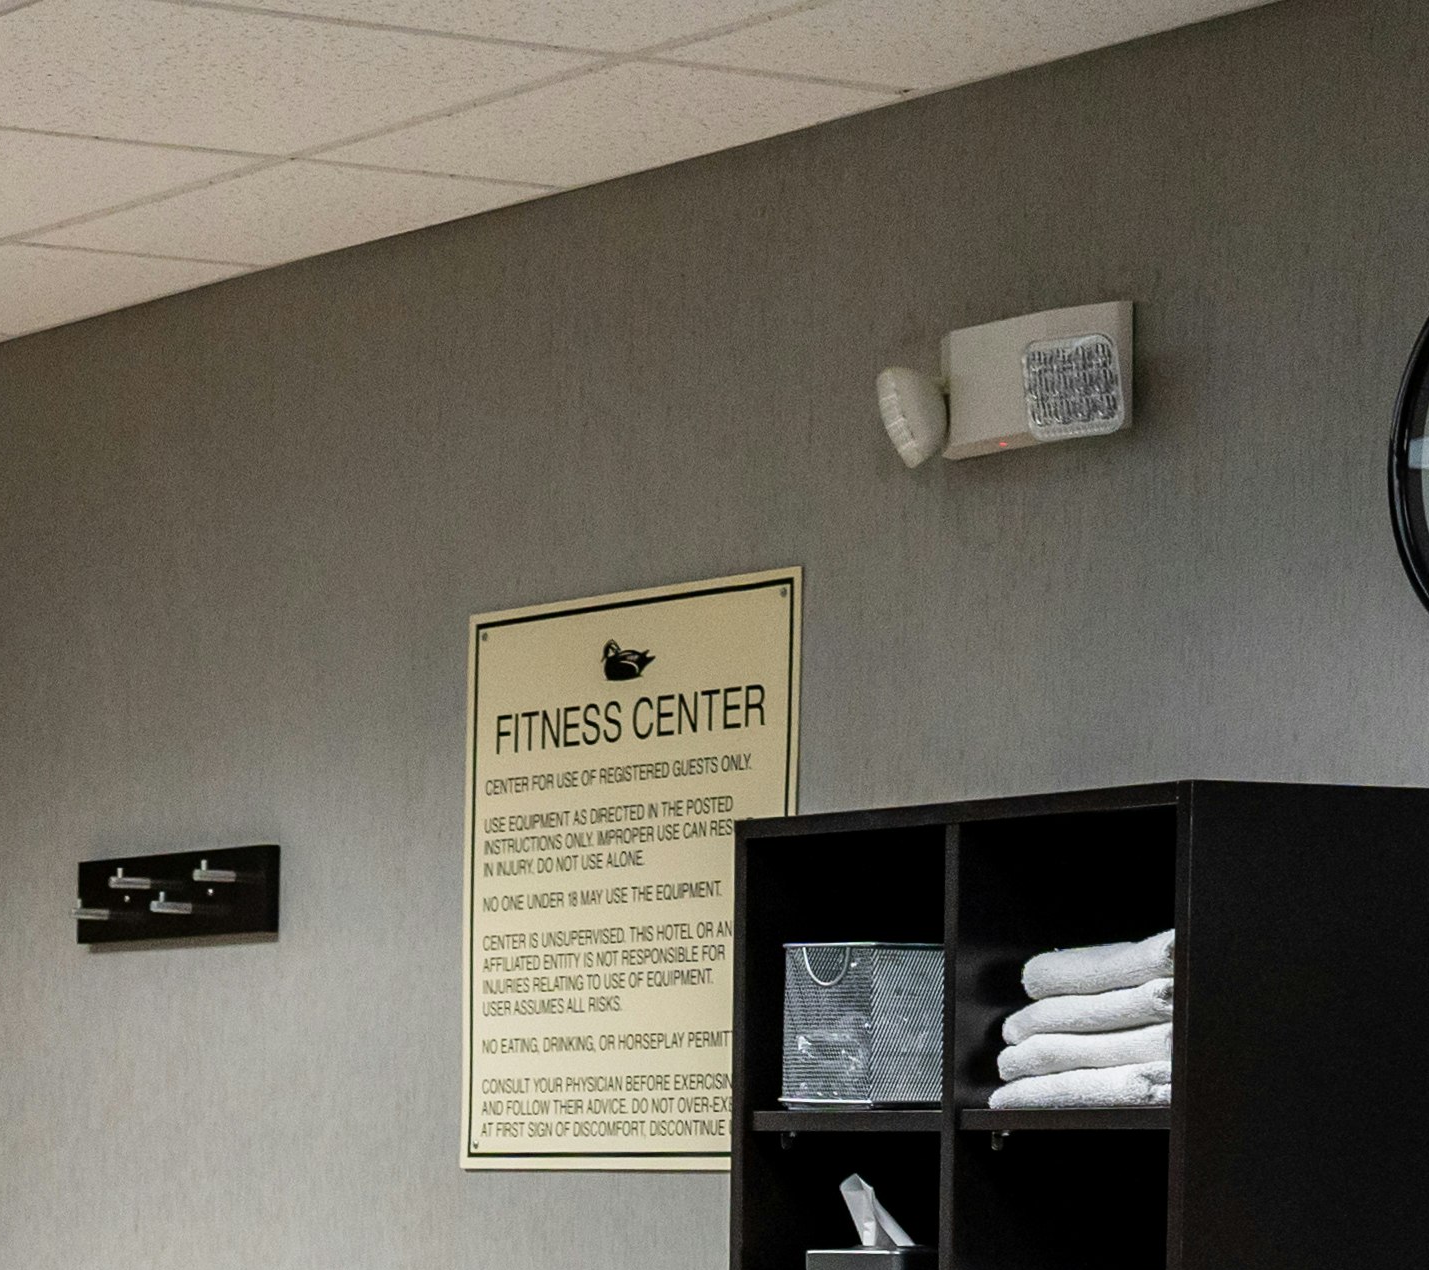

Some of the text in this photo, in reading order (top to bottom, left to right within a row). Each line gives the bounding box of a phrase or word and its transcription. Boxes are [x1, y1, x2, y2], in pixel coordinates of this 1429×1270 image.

[496, 685, 766, 755] FITNESS CENTER
[486, 775, 528, 796] CENTER
[532, 773, 554, 791] FOR
[557, 770, 579, 788] USE
[583, 769, 597, 786] OF
[599, 762, 669, 784] REGISTERED
[673, 757, 718, 778] GUESTS
[485, 796, 733, 833] USE EQUIPMENT AS DIRECTED IN THE POSTED
[484, 832, 562, 855] INSTRUCTIONS
[597, 825, 654, 847] IMPROPER
[657, 824, 680, 841] USE
[683, 820, 706, 839] CAN
[710, 818, 733, 836] RES
[484, 861, 493, 877] IN
[537, 855, 553, 873] DO
[555, 853, 579, 872] NOT
[582, 852, 603, 869] USE
[483, 897, 498, 912] NO
[501, 894, 524, 911] ONE
[527, 892, 564, 909] UNDER
[568, 891, 577, 907] 18
[580, 889, 603, 906] MAY
[606, 888, 628, 904] USE
[631, 886, 653, 902] THE
[483, 932, 525, 951] CENTER
[529, 932, 538, 948] IS
[630, 926, 653, 943] THIS
[657, 923, 693, 940] HOTEL
[697, 921, 714, 938] OR
[483, 945, 725, 972] AFFILIATED ENTITY IS NOT RESPONSIBLE FOR
[483, 975, 529, 994] INJURIES
[533, 974, 584, 992] RELATING
[587, 973, 600, 989] TO
[603, 971, 626, 989] USE
[629, 971, 644, 987] OF
[483, 999, 511, 1016] USER
[514, 998, 564, 1015] ASSUMES
[567, 997, 585, 1013] ALL
[482, 1038, 497, 1054] NO
[599, 1033, 615, 1050] OR
[618, 1031, 684, 1049] HORSEPLAY
[482, 1077, 530, 1094] CONSULT
[533, 1077, 563, 1093] YOUR
[567, 1076, 622, 1093] PHYSICIAN
[626, 1075, 670, 1091] BEFORE
[482, 1100, 503, 1116] AND
[507, 1099, 550, 1115] FOLLOW
[553, 1098, 583, 1115] THEIR
[632, 1098, 647, 1113] DO
[650, 1098, 674, 1113] NOT
[481, 1122, 493, 1137] AT
[496, 1121, 524, 1136] FIRST
[528, 1121, 552, 1136] SIGN
[556, 1120, 570, 1136] OF
[650, 1119, 725, 1136] DISCONTINUE
